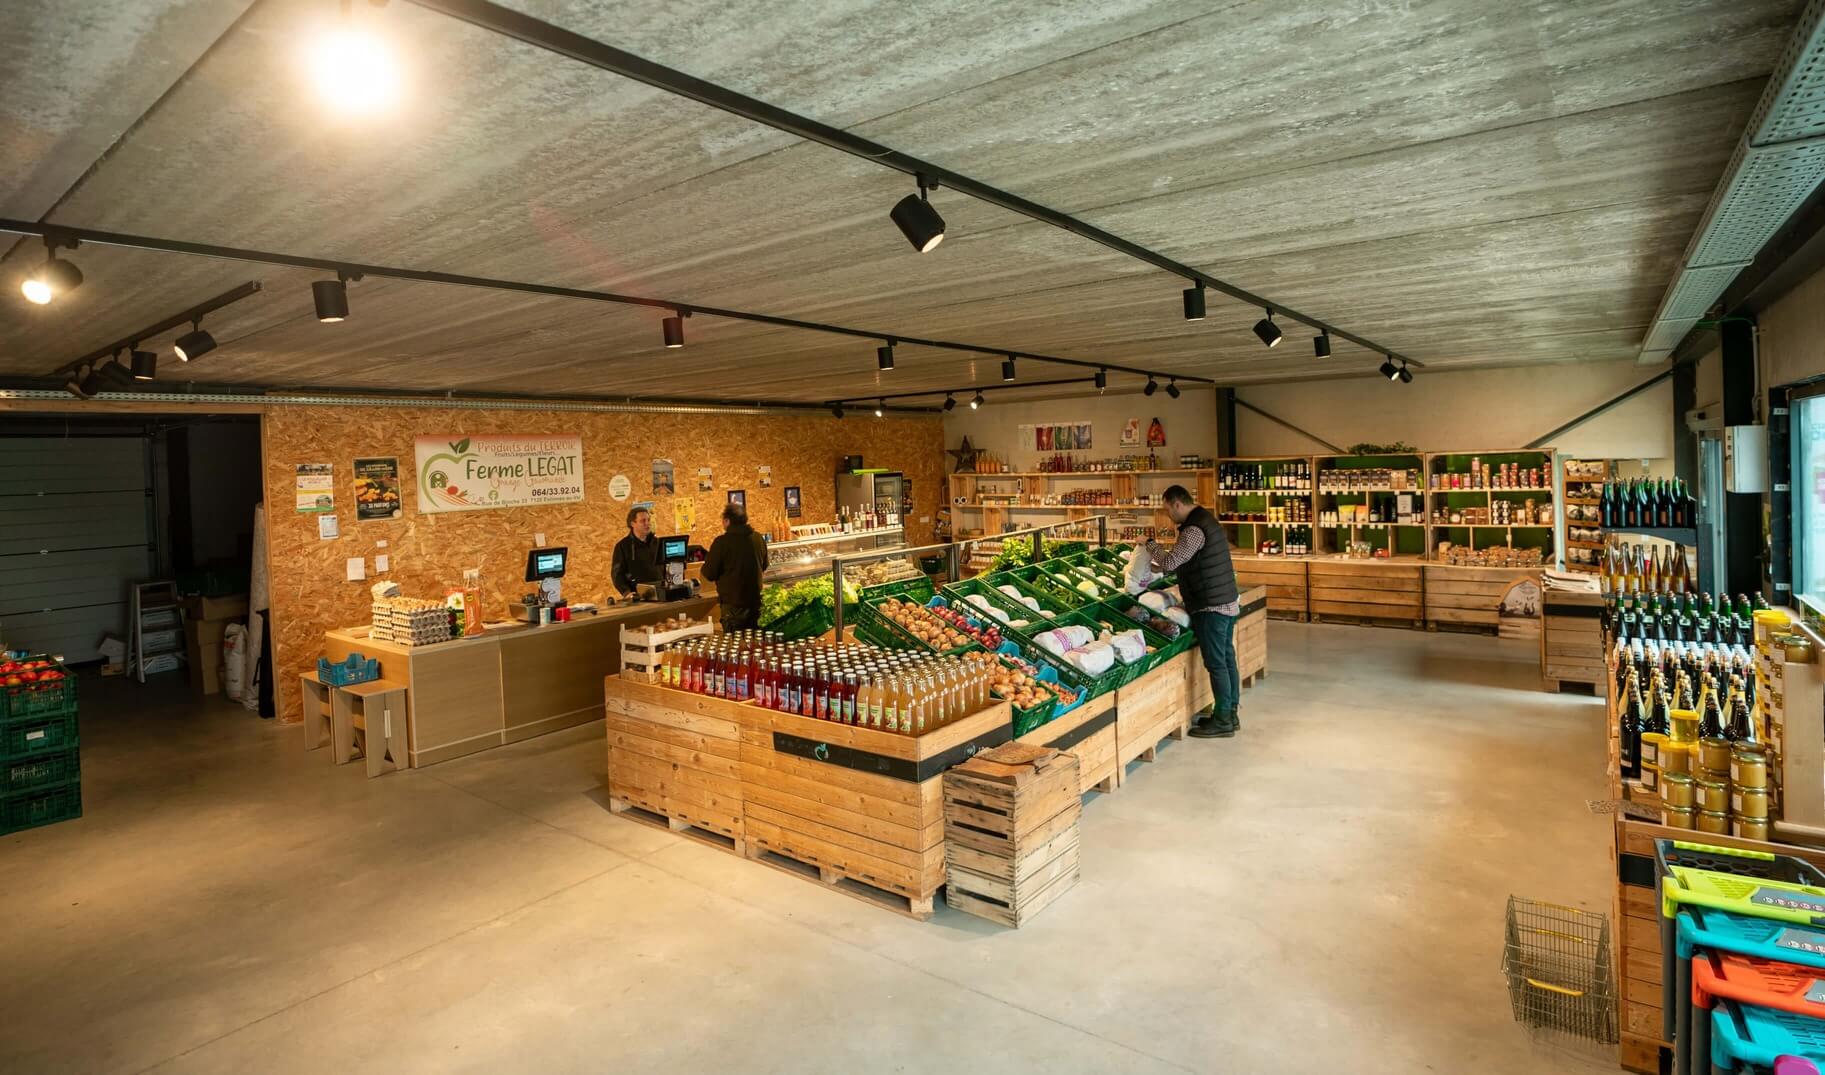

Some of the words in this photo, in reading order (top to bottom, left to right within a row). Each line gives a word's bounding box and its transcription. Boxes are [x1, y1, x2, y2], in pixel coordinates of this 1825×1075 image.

[478, 440, 521, 452] Produits
[524, 442, 536, 451] du
[466, 459, 524, 480] Ferme
[528, 456, 576, 477] LEGAT
[532, 486, 580, 497] 064/33.92.04
